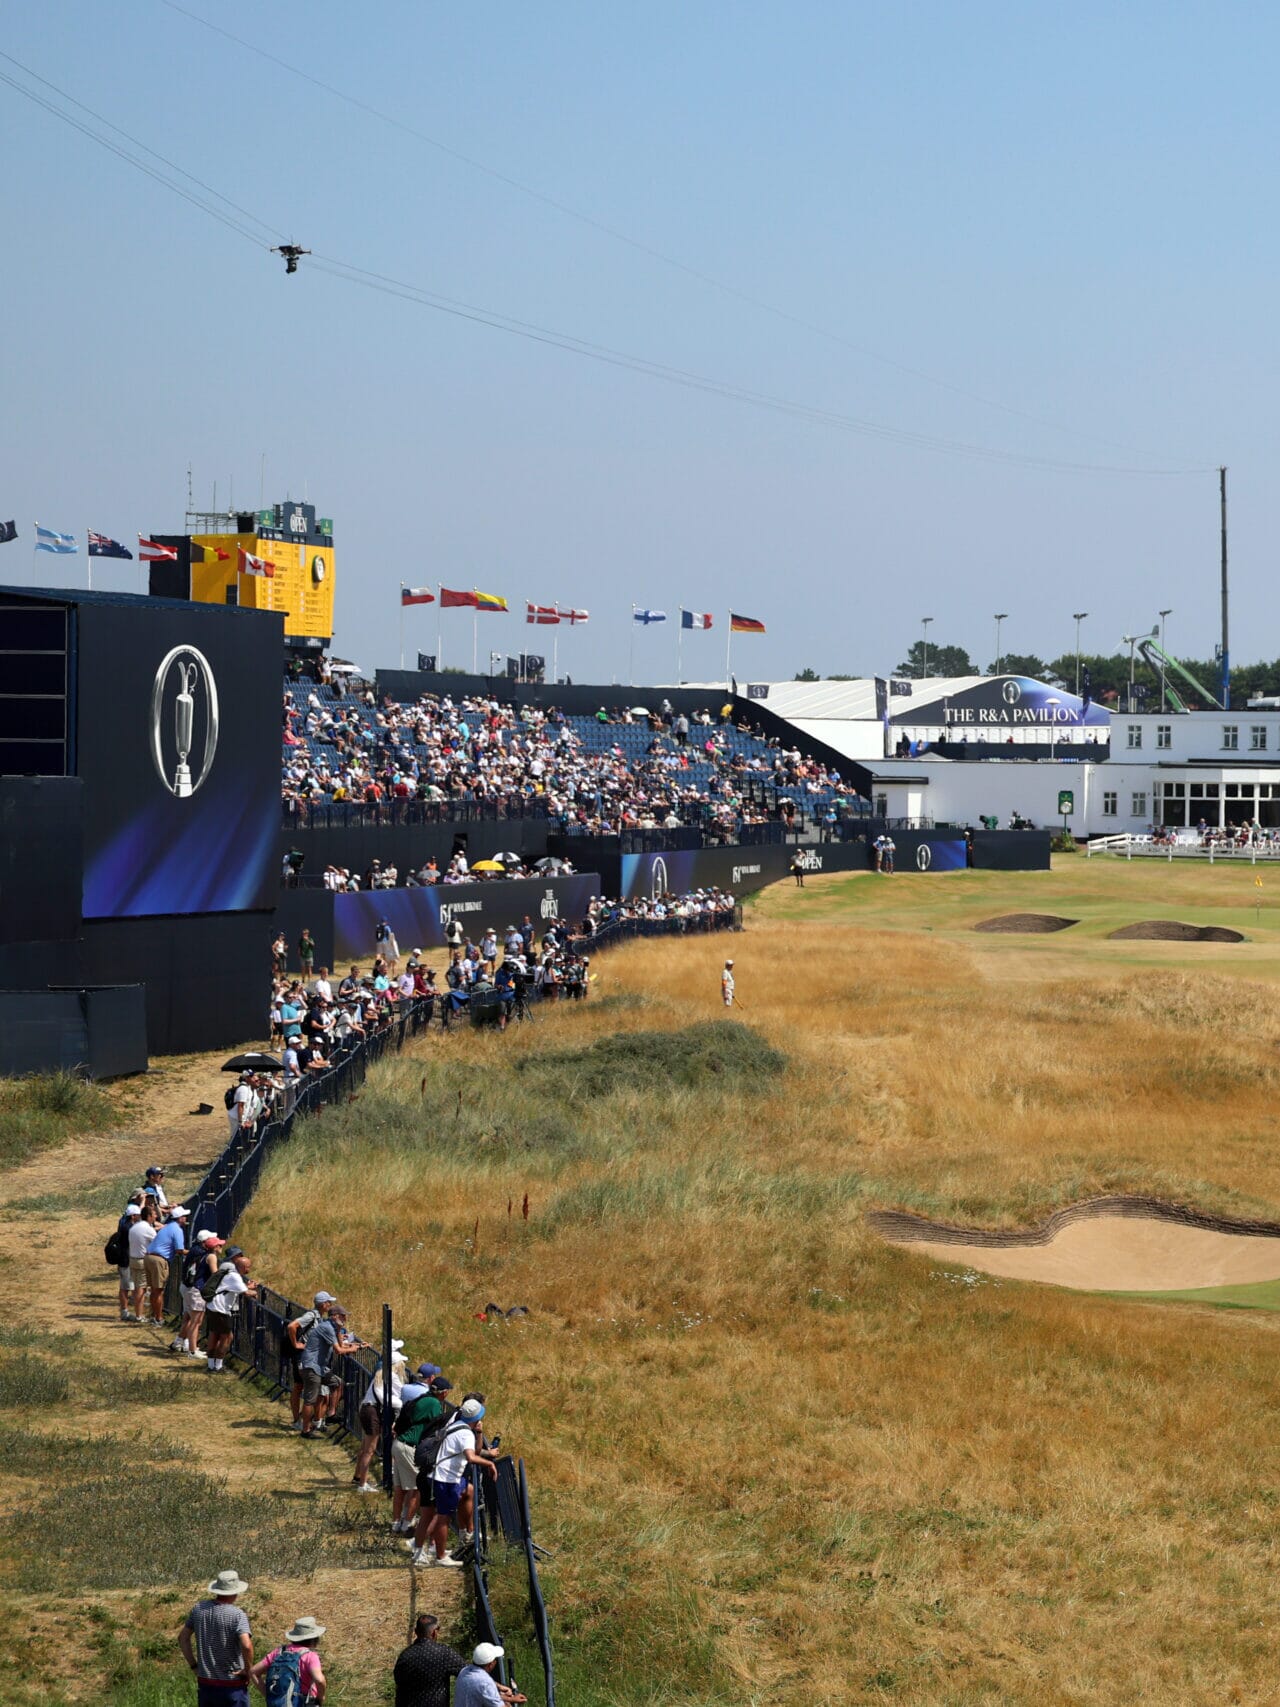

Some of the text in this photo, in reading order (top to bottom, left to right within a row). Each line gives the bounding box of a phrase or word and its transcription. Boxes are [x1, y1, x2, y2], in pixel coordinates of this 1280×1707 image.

[290, 514, 308, 533] OPEN
[943, 708, 1079, 722] THE R&A PAVILION
[805, 849, 816, 857] THE
[801, 856, 823, 870] OPEN
[540, 898, 559, 919] OPEN
